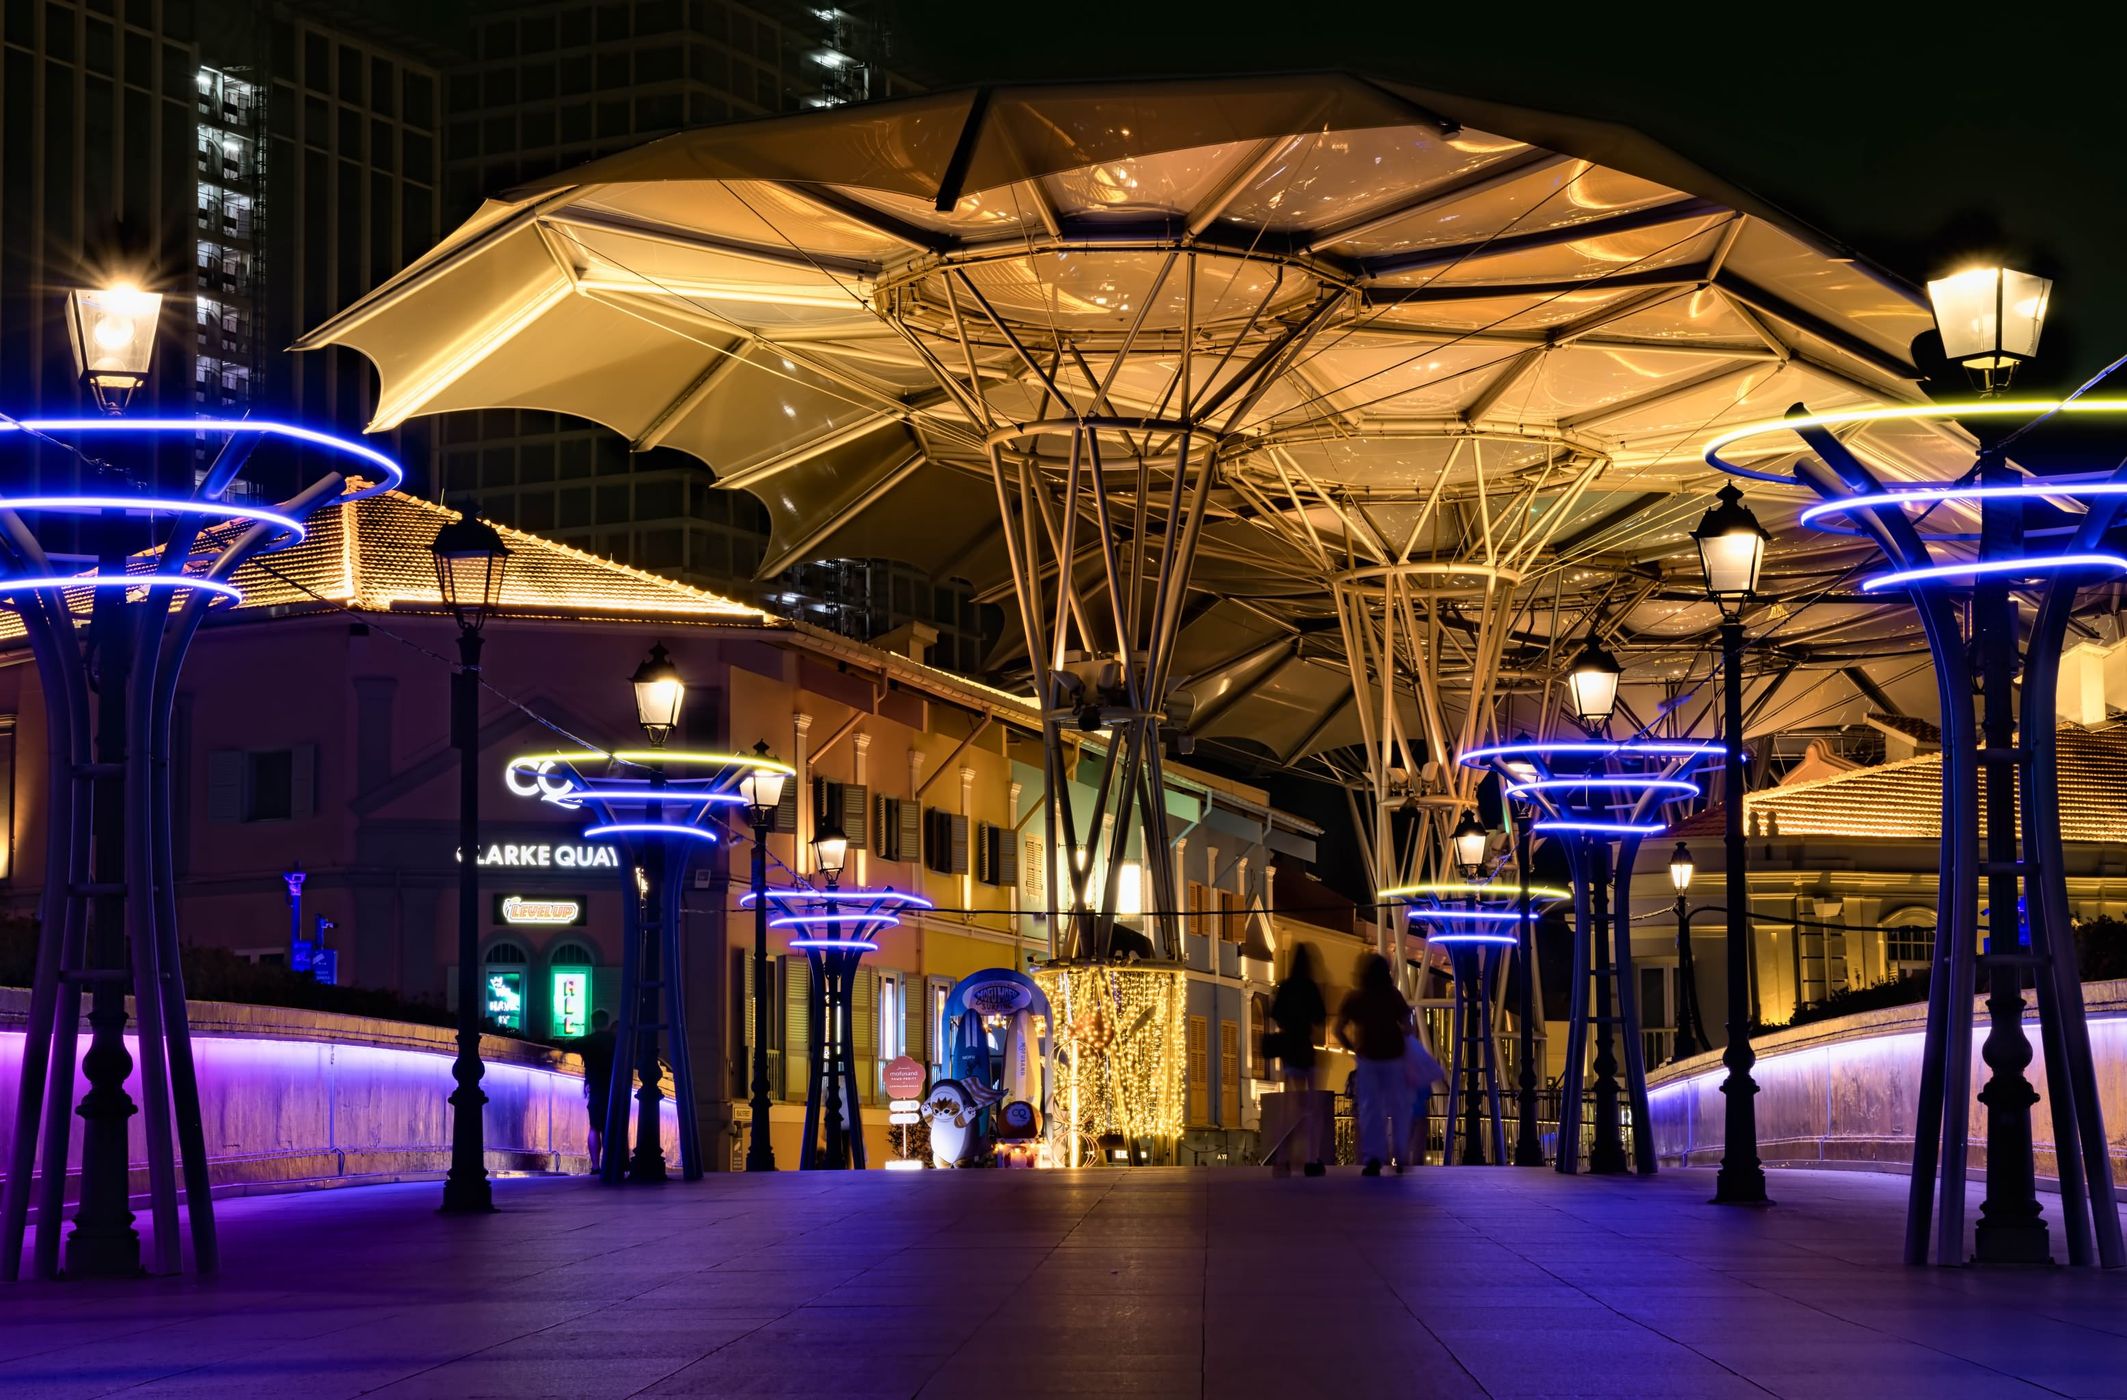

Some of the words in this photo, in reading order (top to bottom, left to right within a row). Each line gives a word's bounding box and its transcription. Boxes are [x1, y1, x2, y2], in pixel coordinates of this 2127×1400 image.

[456, 845, 550, 866] LARKE
[511, 905, 552, 918] LEVEL
[552, 905, 574, 918] UP
